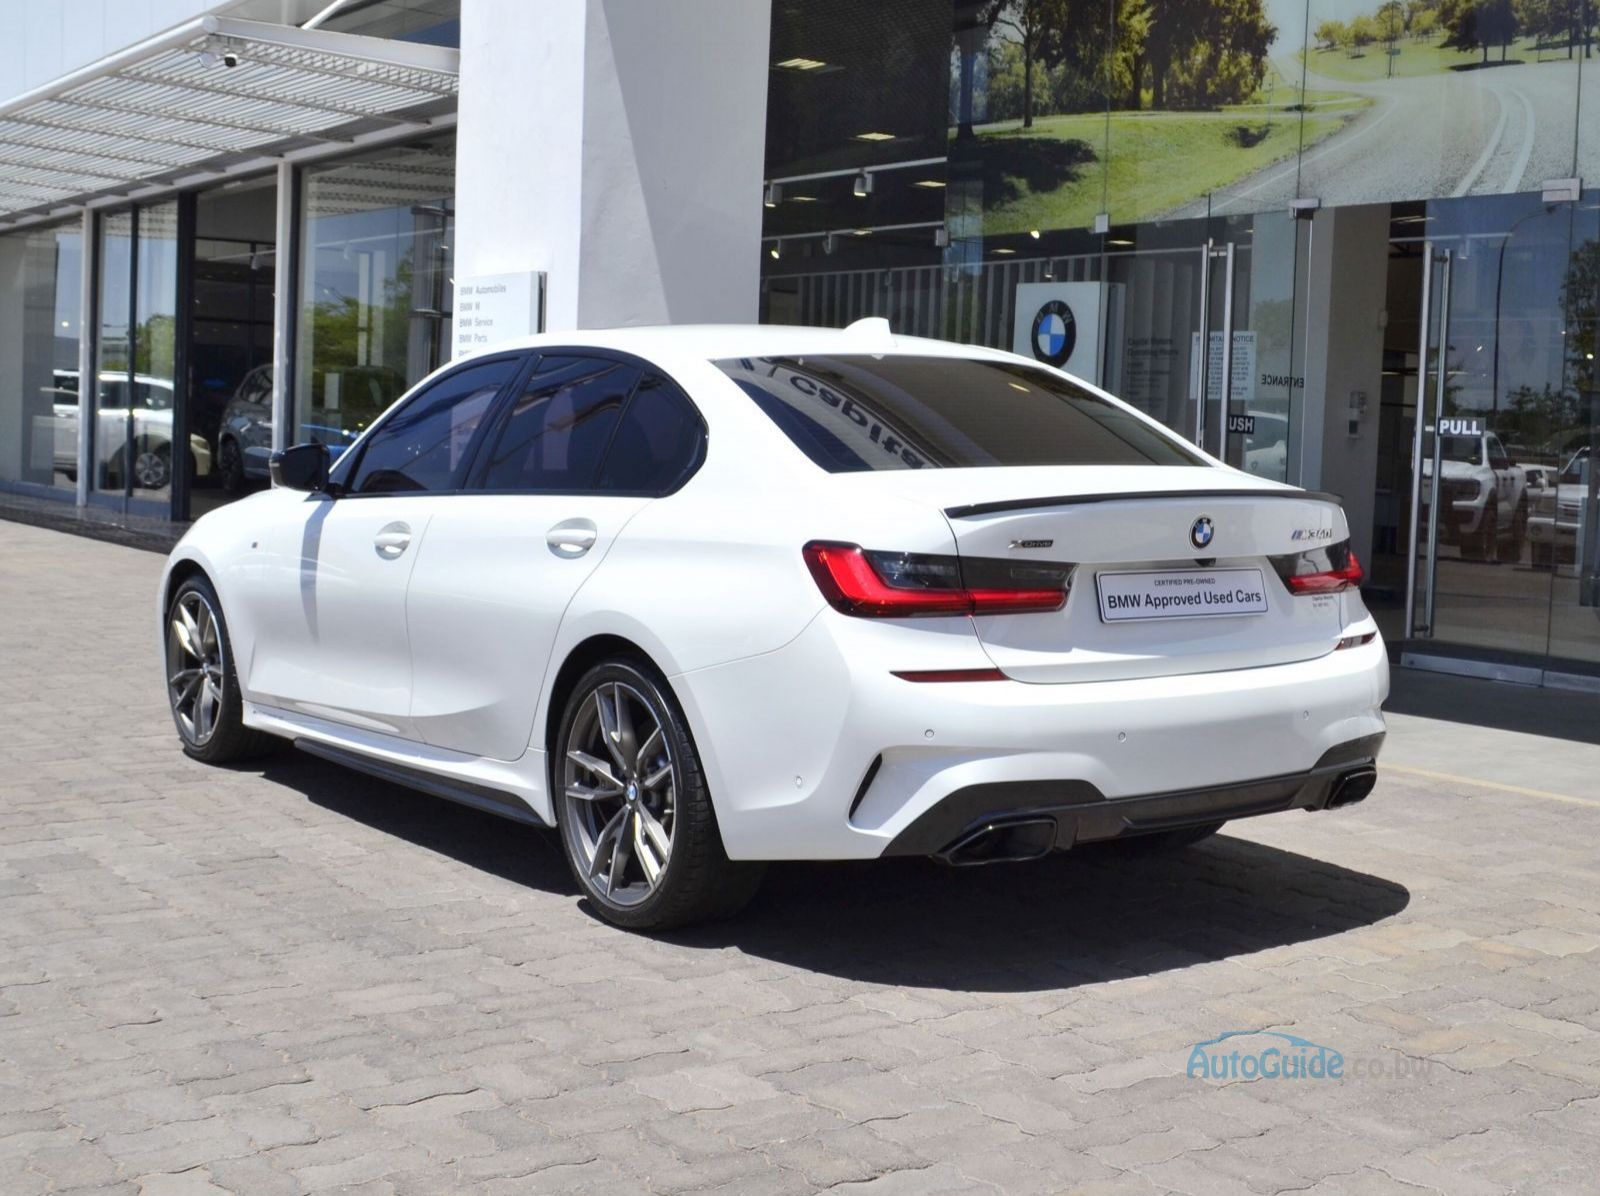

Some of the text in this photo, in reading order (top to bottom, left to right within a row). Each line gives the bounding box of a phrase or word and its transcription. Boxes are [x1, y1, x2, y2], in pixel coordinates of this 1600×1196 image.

[1228, 417, 1253, 432] USH
[1440, 420, 1481, 435] PULL
[1154, 577, 1216, 587] CERTIFIED PRE-OWNED
[1107, 589, 1262, 610] BMW Approved Used Cars
